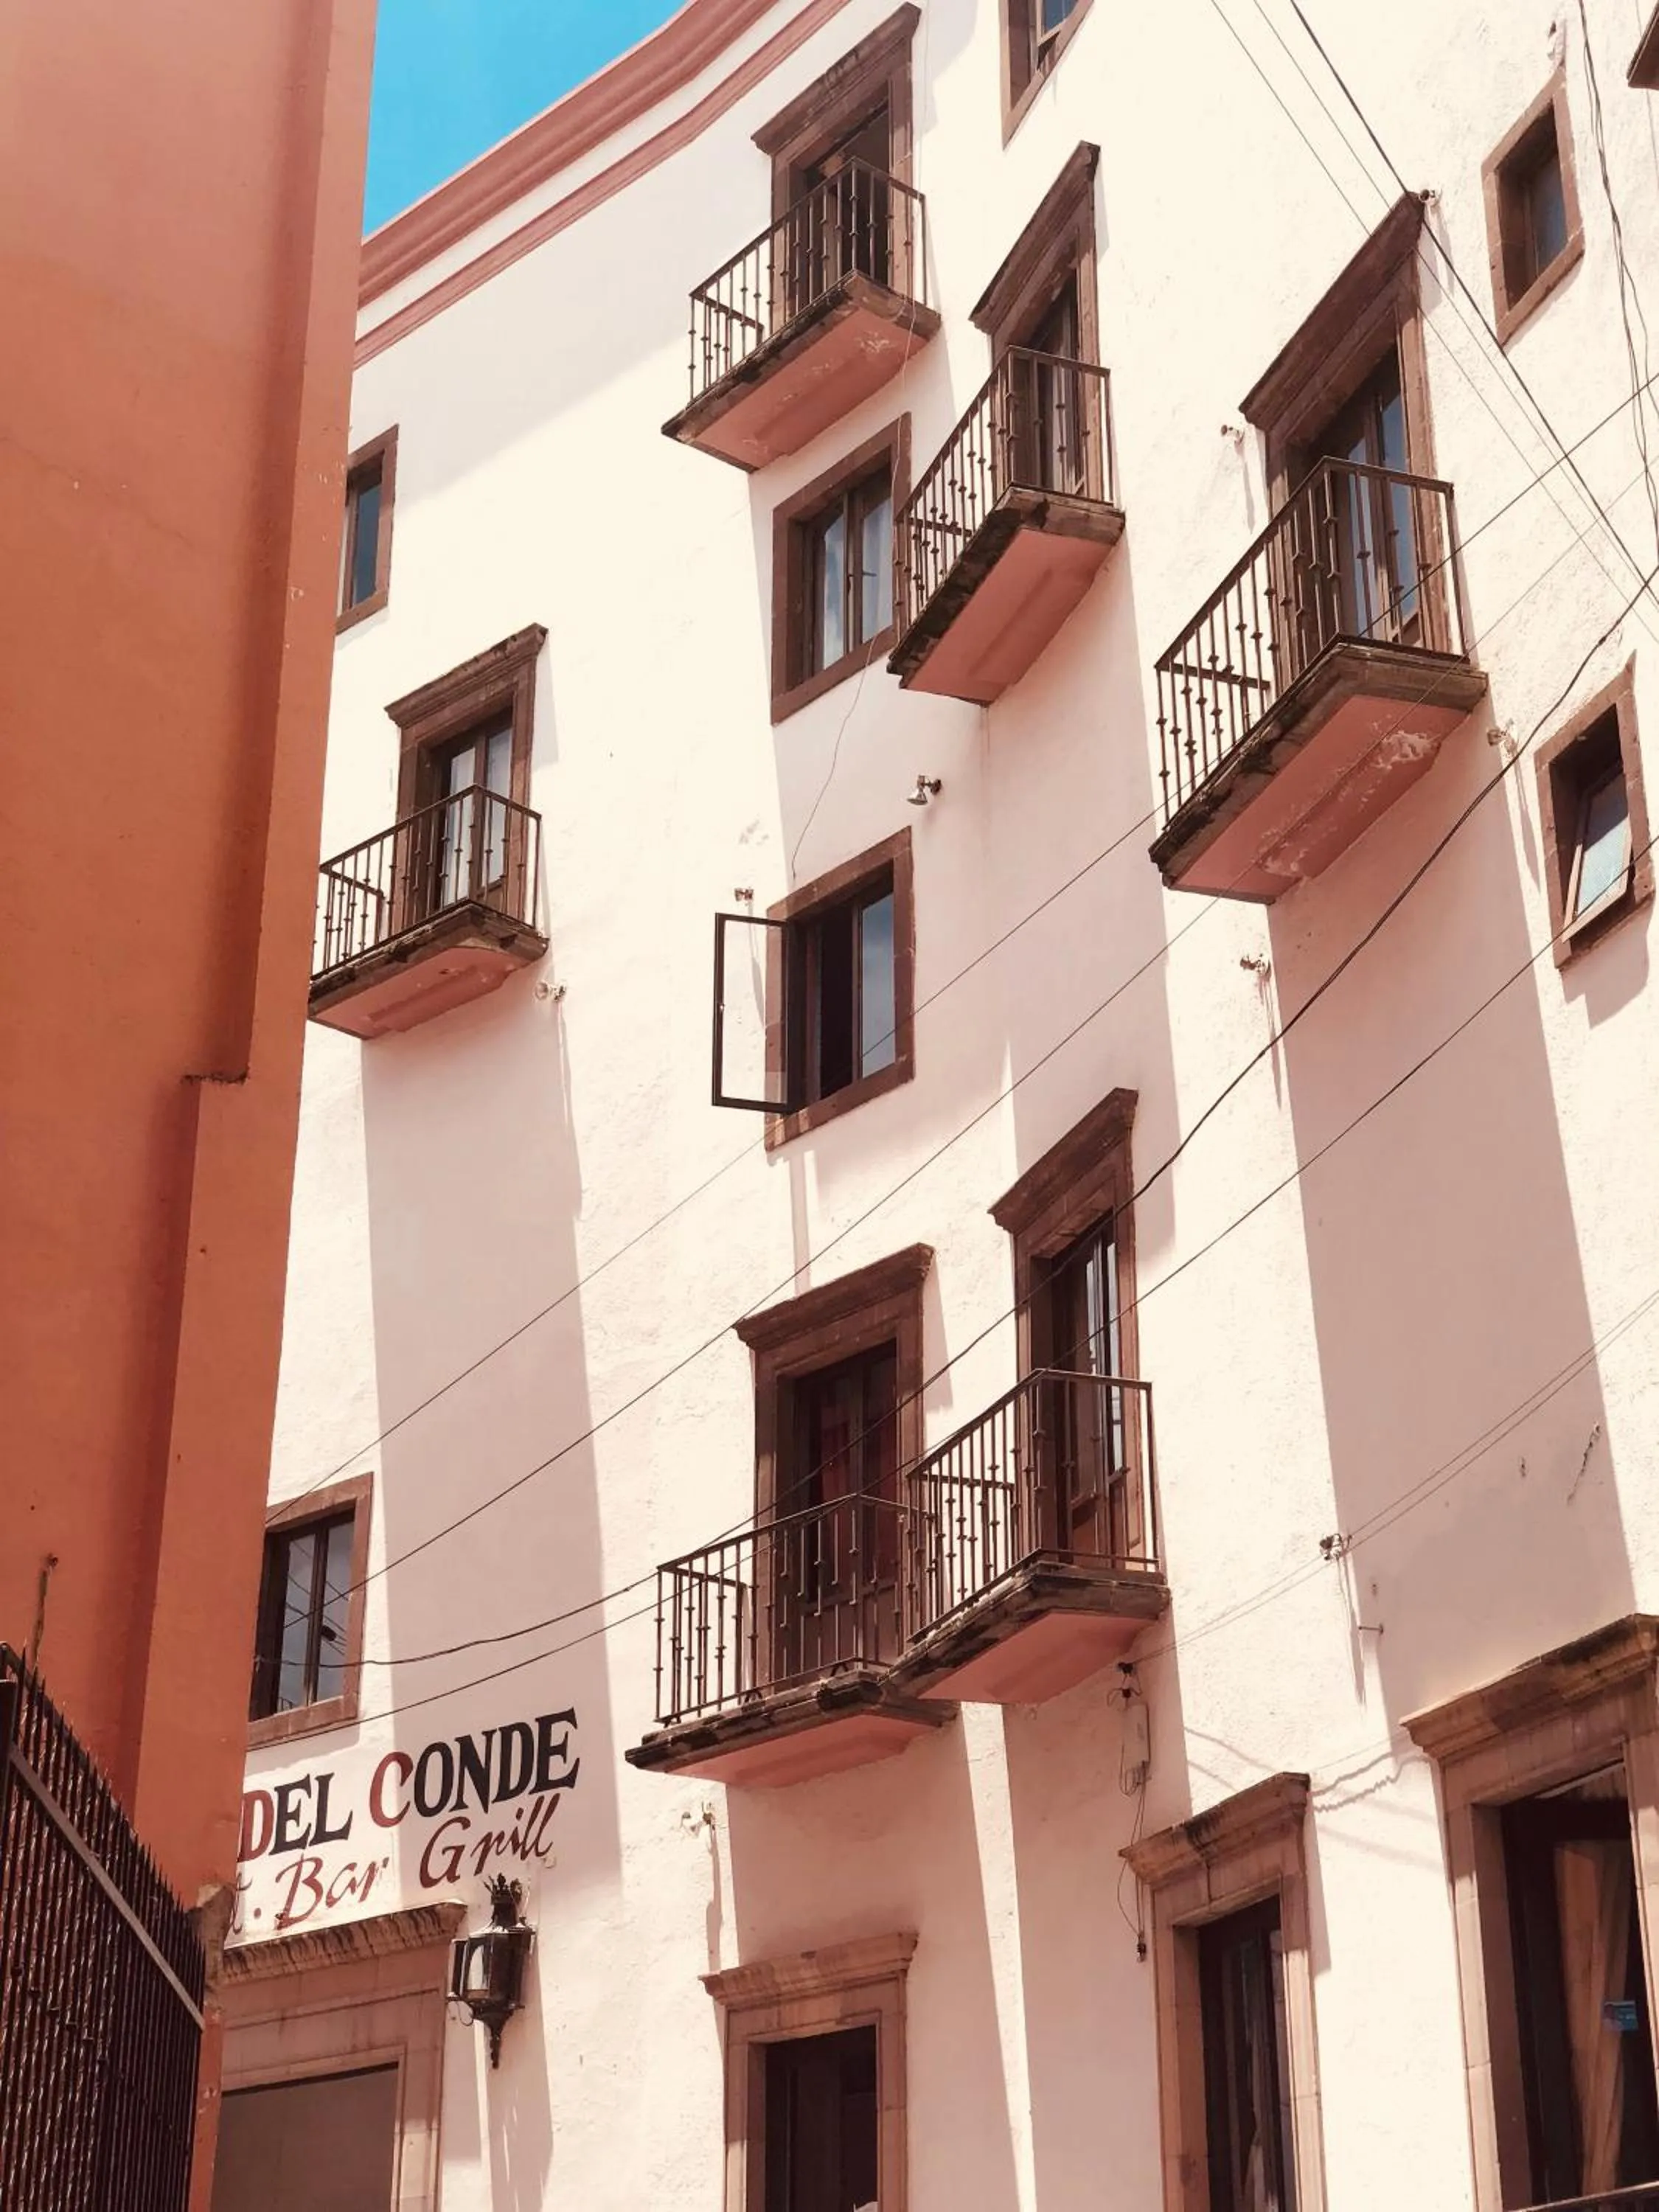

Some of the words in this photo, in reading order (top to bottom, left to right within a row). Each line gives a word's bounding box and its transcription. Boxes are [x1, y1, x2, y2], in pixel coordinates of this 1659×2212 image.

[237, 1773, 353, 1863] DEL
[369, 1707, 580, 1828] CONDE
[275, 1853, 389, 1930] Bar
[419, 1792, 560, 1888] Grill
